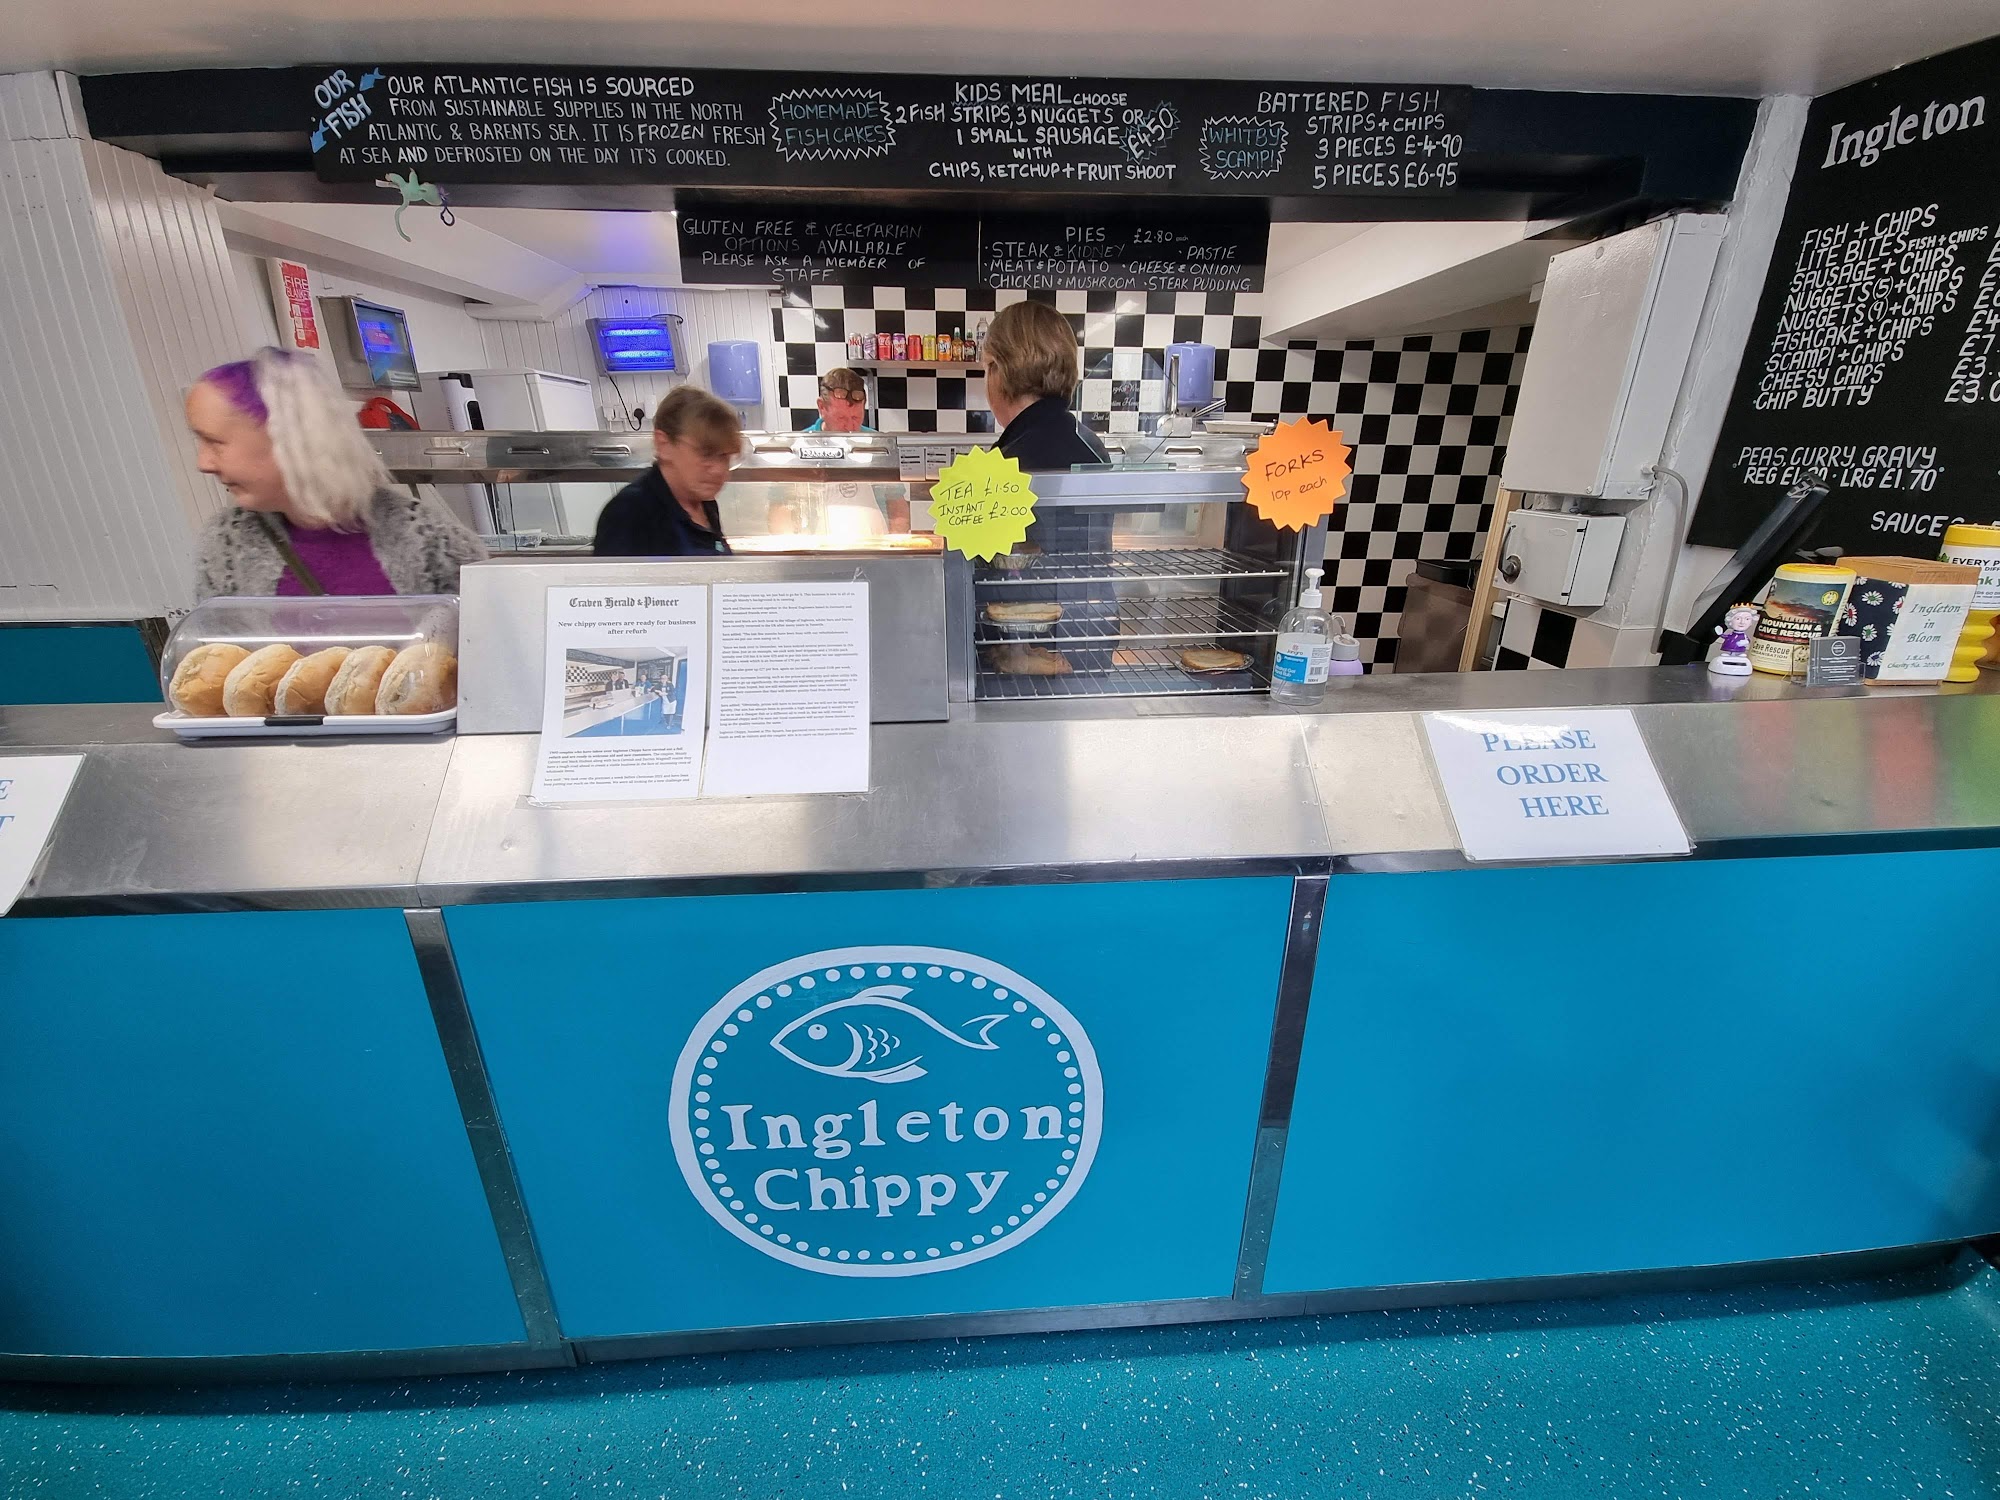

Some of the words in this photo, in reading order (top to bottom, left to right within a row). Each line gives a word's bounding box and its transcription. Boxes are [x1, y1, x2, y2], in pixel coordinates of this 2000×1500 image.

[315, 69, 354, 109] OUR
[387, 76, 424, 97] OUR
[434, 75, 528, 96] ATLANTIC
[533, 77, 572, 97] FISH
[579, 78, 597, 96] IS
[605, 77, 694, 98] SOURCED
[955, 82, 1001, 103] KIDS
[1011, 82, 1071, 104] MEAL
[1072, 92, 1128, 107] CHOOSE
[389, 99, 437, 117] FROM
[445, 98, 546, 118] SUSTAINABLE
[554, 101, 625, 120] SUPPLIES
[631, 102, 647, 120] IN
[651, 102, 681, 120] THE
[691, 103, 743, 121] NORTH
[780, 100, 879, 120] HOMEMADE
[1257, 90, 1370, 113] BATTERED
[1380, 89, 1440, 113] FISH
[326, 93, 374, 138] FISH
[909, 102, 945, 123] FISH
[1033, 104, 1113, 125] NUGGETS
[1122, 108, 1146, 127] OR
[368, 123, 442, 141] ATLANTIC
[450, 124, 462, 141] &
[468, 123, 541, 140] BARENTS
[549, 124, 587, 142] SEA.
[593, 123, 610, 142] IT
[619, 124, 634, 141] IS
[637, 123, 704, 141] FROZEN
[712, 125, 766, 145] FRESH
[970, 126, 1028, 145] SMALL
[1035, 126, 1120, 147] SAUSAGE
[1209, 126, 1281, 147] WHITBY
[1821, 95, 1986, 169] Ingleton
[340, 146, 356, 164] AT
[363, 146, 392, 164] SEA
[396, 146, 428, 164] AND
[434, 146, 522, 164] DEFROSTED
[529, 146, 551, 163] ON
[557, 147, 588, 165] THE
[595, 147, 620, 165] DAY
[629, 147, 657, 166] IT'S
[665, 149, 731, 167] COOKED.
[1012, 146, 1053, 160] WITH
[1314, 136, 1329, 159] 3
[1335, 135, 1395, 158] PIECES
[1124, 164, 1177, 181] SHOOT
[1313, 165, 1327, 189] 5
[1332, 162, 1400, 187] PIECES
[683, 218, 744, 236] GLUTEN
[755, 221, 793, 236] FREE
[824, 222, 922, 239] VEGETARIAN
[1065, 227, 1106, 242] PIES
[1801, 222, 1850, 253] FISH
[1853, 220, 1870, 235] +
[1874, 203, 1939, 237] CHIPS
[724, 238, 800, 252] OPTIONS
[816, 240, 906, 256] AVAILABLE
[992, 241, 1046, 258] STEAK
[1066, 243, 1126, 259] KIDNEY
[1186, 245, 1238, 260] PASTIE
[1796, 243, 1843, 273] LITE
[1844, 231, 1910, 263] BITES
[1907, 234, 1937, 252] FISH
[1948, 226, 1989, 244] CHIPS
[701, 251, 755, 266] PLEASE
[764, 254, 791, 266] ASK
[802, 255, 813, 267] A
[825, 256, 887, 269] MEMBER
[907, 257, 926, 269] OF
[990, 259, 1034, 273] MEAT
[1046, 259, 1110, 274] POTATO
[1128, 261, 1177, 275] CHEESE
[1190, 264, 1242, 275] ONION
[1790, 257, 1880, 293] SAUSAGE
[1881, 258, 1897, 274] +
[1900, 244, 1958, 275] CHIPS
[989, 274, 1053, 289] CHICKEN
[1065, 276, 1136, 289] MUSHROOM
[1148, 276, 1189, 290] STEAK
[1192, 277, 1251, 291] PUDDING
[1772, 322, 1864, 353] FISHCAKE
[1878, 316, 1935, 341] CHIPS
[1766, 346, 1836, 373] SCAMPI
[1850, 340, 1906, 365] CHIPS
[1760, 367, 1829, 392] CHEESY
[1833, 362, 1886, 386] CHIPS
[1755, 389, 1799, 410] CHIP
[1801, 384, 1875, 408] BUTTY
[1265, 449, 1325, 482] FORKS
[1861, 446, 1937, 469] GRAVY
[1743, 466, 1777, 485] REG
[1839, 468, 1877, 489] LRG
[940, 480, 974, 501] TEA
[1271, 490, 1291, 501] 10p
[1299, 476, 1328, 494] each
[938, 500, 986, 517] INSTANT
[948, 513, 985, 527] COFFEE
[1952, 557, 1992, 567] EVERY
[569, 597, 603, 608] Craven
[604, 596, 636, 610] Herald
[644, 596, 680, 609] Pioneer
[1908, 601, 1962, 617] Ingleton
[557, 620, 574, 628] New
[574, 620, 597, 629] chippy
[636, 619, 655, 628] ready
[656, 618, 668, 627] for
[667, 618, 697, 626] business
[607, 627, 625, 635] after
[625, 627, 648, 635] refurb
[1757, 624, 1780, 636] CAVE
[1779, 628, 1823, 639] RESCUE
[1761, 617, 1813, 632] MOUNTAIN
[1813, 623, 1823, 632] &
[1922, 618, 1936, 630] in
[1905, 632, 1942, 644] Bloom
[1764, 643, 1791, 656] Rescue
[1496, 762, 1609, 785] ORDER
[1519, 794, 1610, 818] HERE
[720, 1098, 1065, 1160] Ingleton
[754, 1164, 1010, 1218] Chippy
